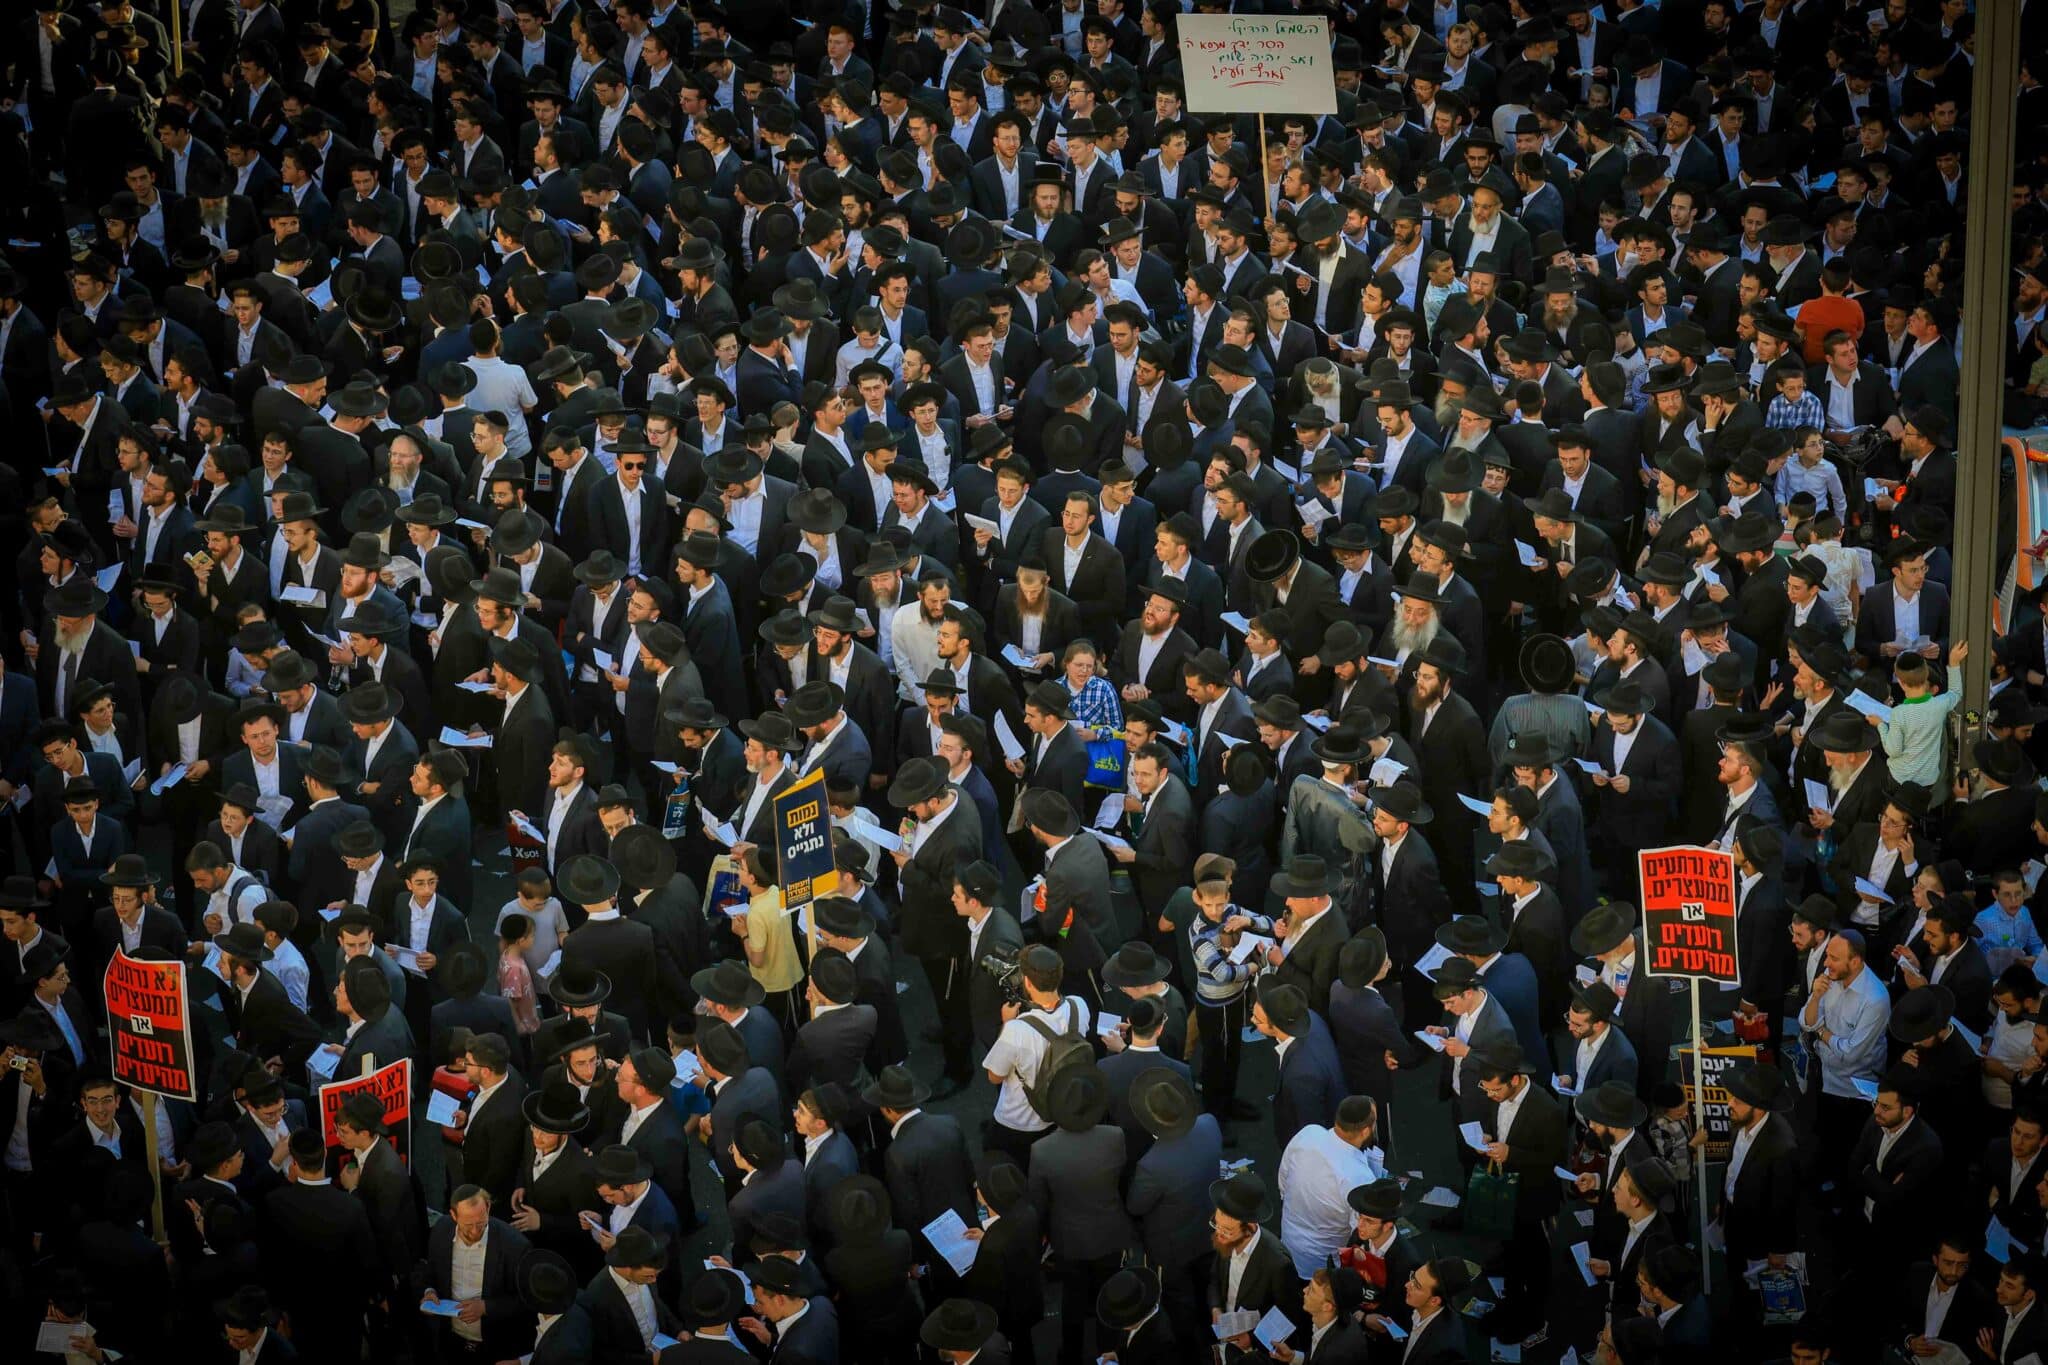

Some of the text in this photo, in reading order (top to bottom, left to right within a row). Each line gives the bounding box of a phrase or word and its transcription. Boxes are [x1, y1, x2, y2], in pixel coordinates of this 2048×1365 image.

[1228, 18, 1319, 35] השמאל הרדיקלי
[1257, 40, 1285, 49] הסר
[1290, 55, 1313, 66] ואז
[1250, 62, 1292, 80] לארץ
[790, 805, 816, 825] נמות
[793, 821, 815, 841] ולא
[787, 834, 824, 860] נתגייס
[1646, 855, 1729, 880] לא נרתעים
[1647, 877, 1730, 903] ממעצרים.
[1683, 904, 1703, 919] אך
[1661, 922, 1723, 951] רועדים
[1652, 946, 1735, 976] מהיעדים.
[154, 966, 177, 992] לא
[132, 1016, 150, 1031] אך
[118, 1029, 175, 1066] רועדים
[1701, 1056, 1736, 1072] לעם
[387, 1066, 403, 1092] לא
